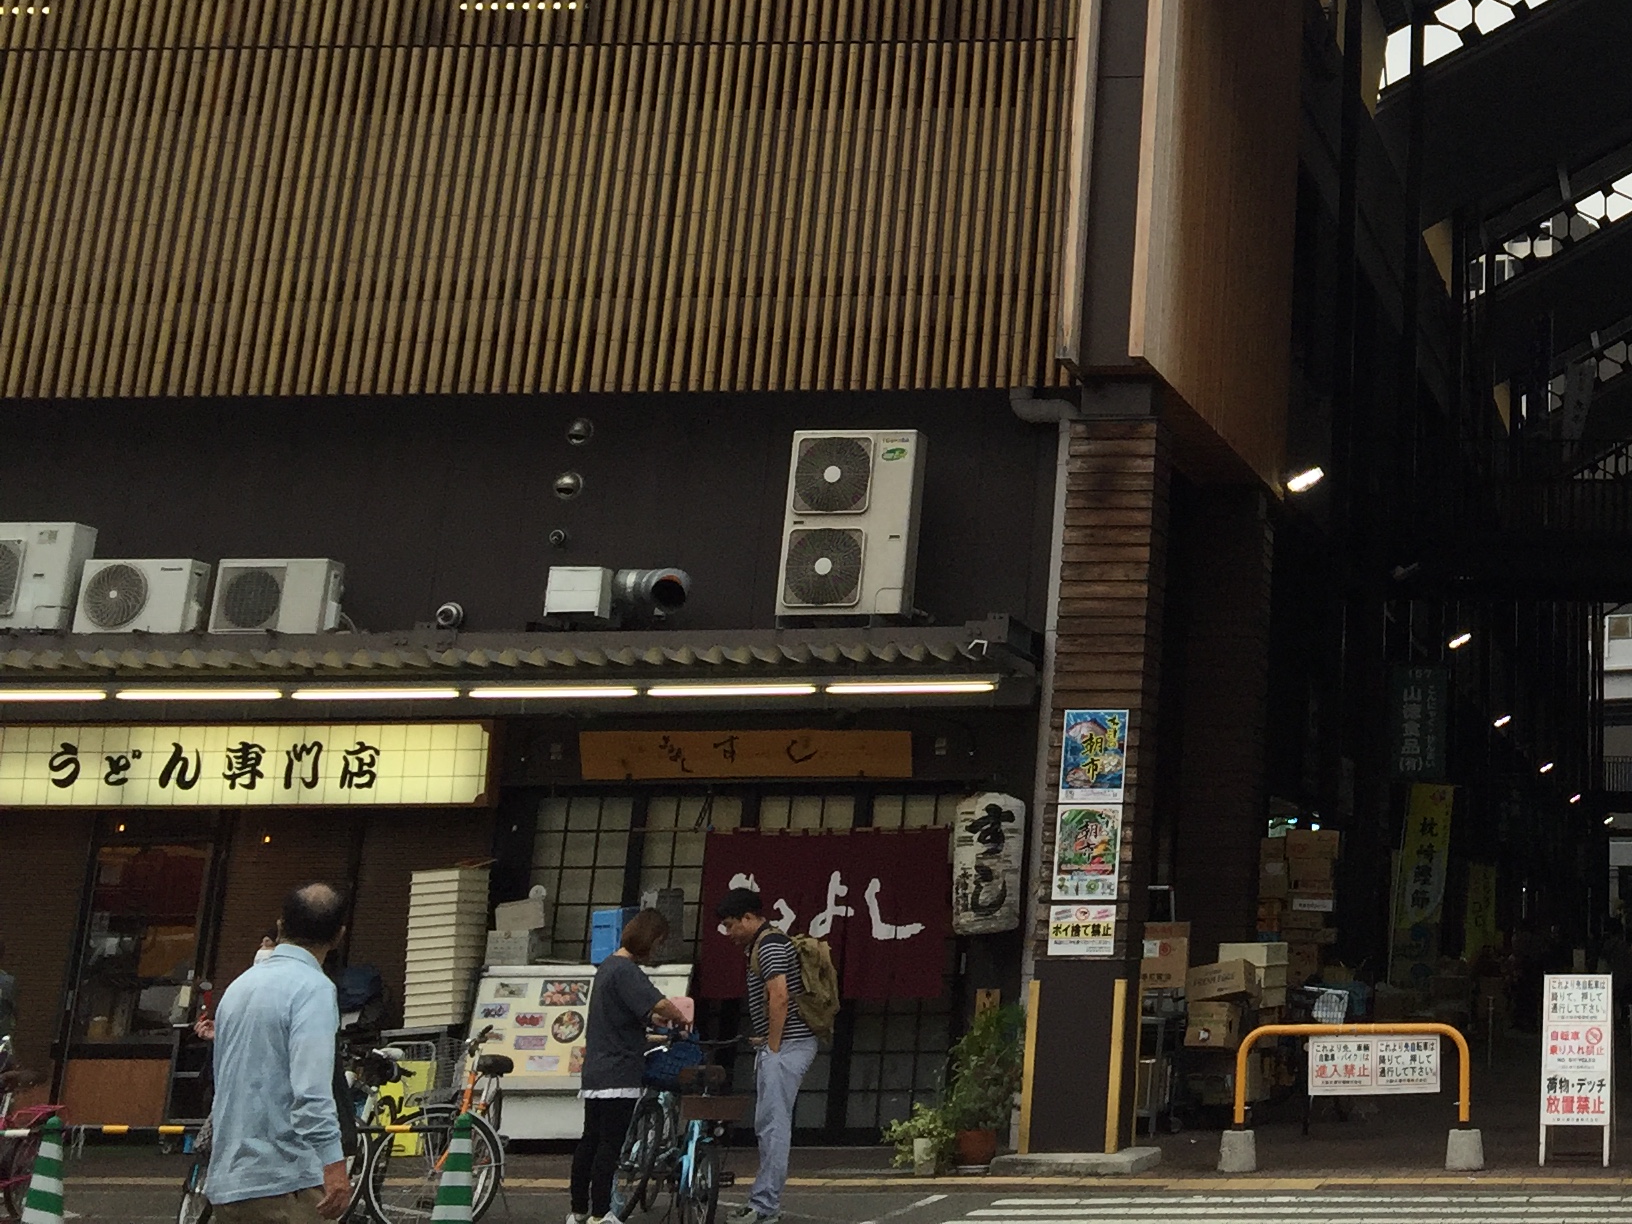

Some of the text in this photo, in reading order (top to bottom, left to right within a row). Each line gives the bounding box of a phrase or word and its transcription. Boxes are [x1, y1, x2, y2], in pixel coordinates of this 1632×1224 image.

[48, 740, 380, 791] うどん専門店
[1081, 732, 1104, 782] 朝市
[964, 802, 1016, 917] すし
[1052, 923, 1112, 937] ポイ捨て禁止
[1315, 1063, 1370, 1078] 進入禁止
[1546, 1074, 1607, 1094] 荷物・デッチ
[1546, 1094, 1606, 1115] 放置禁止
